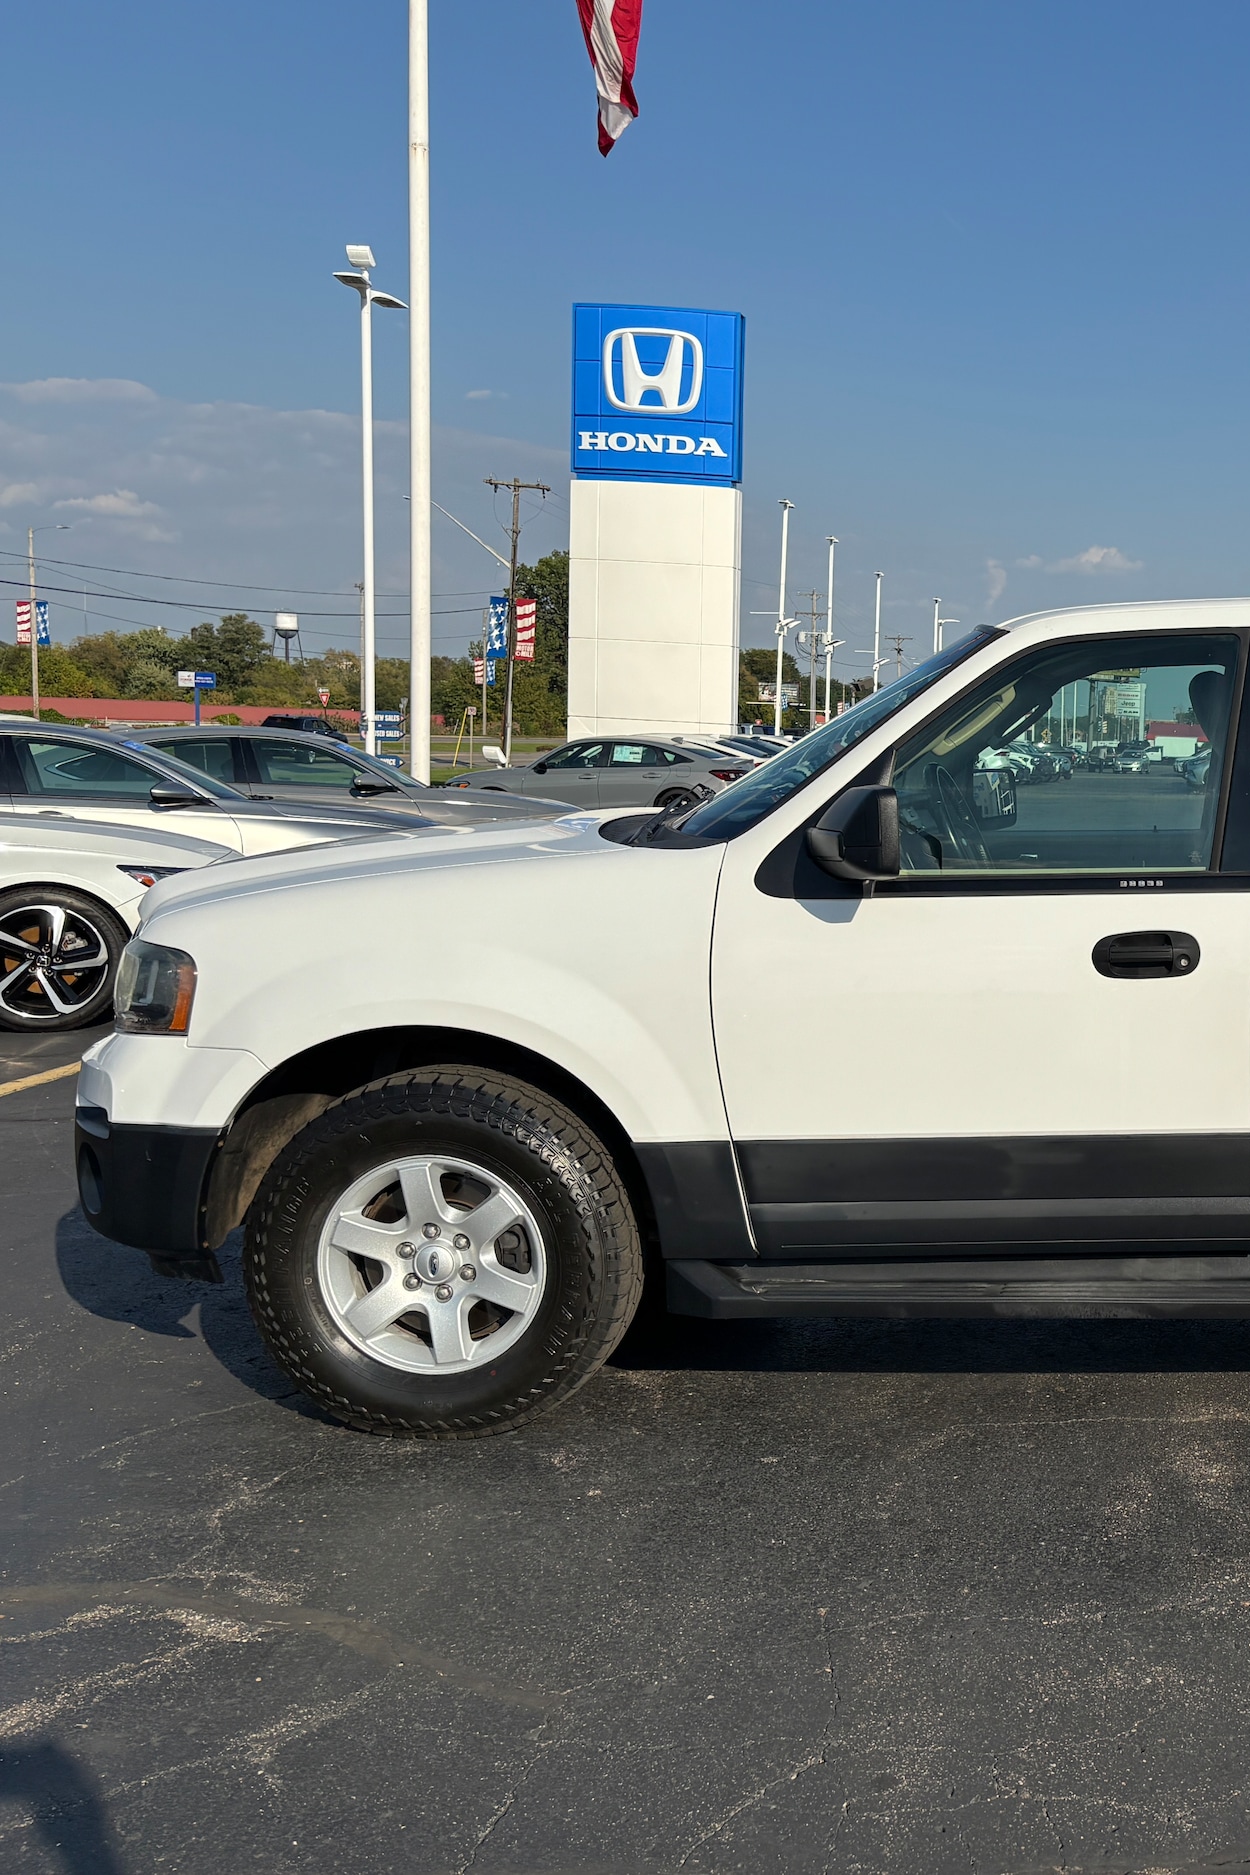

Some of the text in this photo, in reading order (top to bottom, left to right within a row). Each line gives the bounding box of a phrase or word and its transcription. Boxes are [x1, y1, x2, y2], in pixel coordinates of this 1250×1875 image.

[578, 431, 728, 458] HONDA
[384, 714, 400, 722] SALES
[385, 730, 400, 738] SALES
